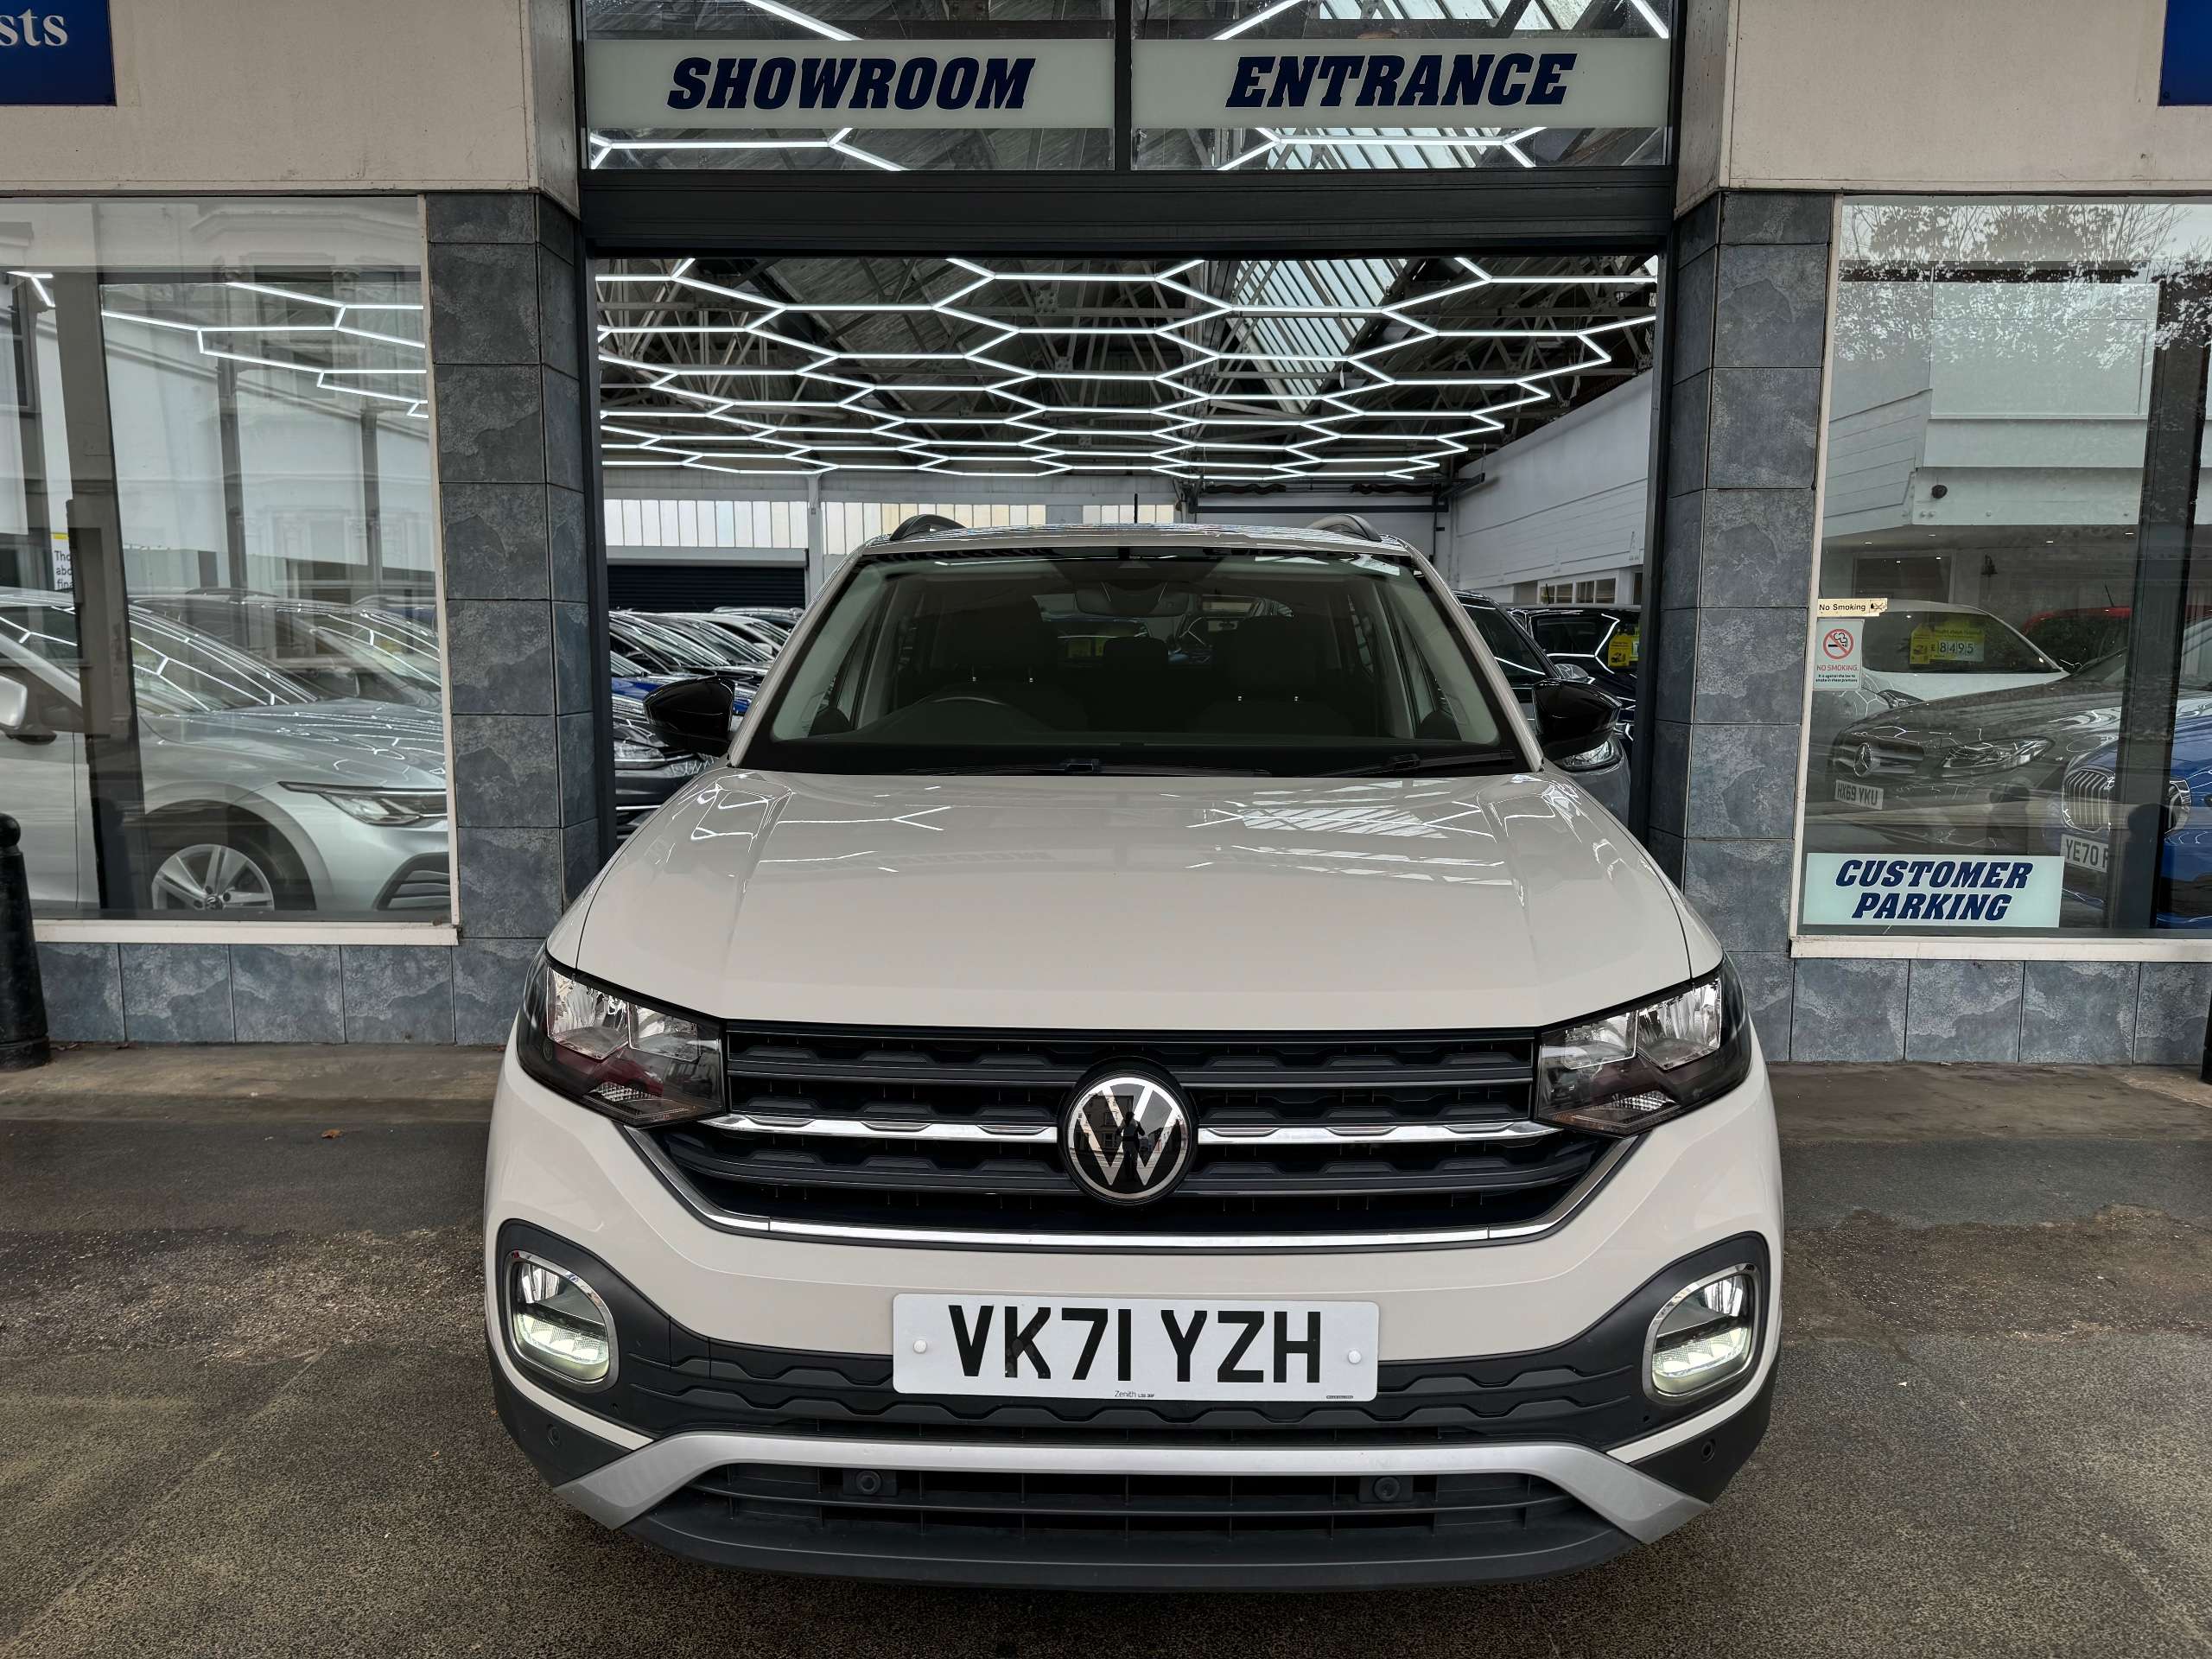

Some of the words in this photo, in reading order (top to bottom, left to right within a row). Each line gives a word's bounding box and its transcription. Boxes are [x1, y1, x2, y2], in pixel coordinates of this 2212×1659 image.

[666, 56, 1036, 110] SHOWROOM
[1225, 53, 1577, 108] ENTRANCE
[1837, 782, 1857, 801] HX69
[1859, 787, 1878, 805] YKU
[2066, 838, 2099, 866] YE70
[1835, 859, 2033, 888] CUSTOMER
[1852, 893, 2012, 921] PARKING
[948, 1305, 1131, 1381] VK71
[1160, 1309, 1321, 1382] YZH
[1114, 1389, 1137, 1398] Zenith
